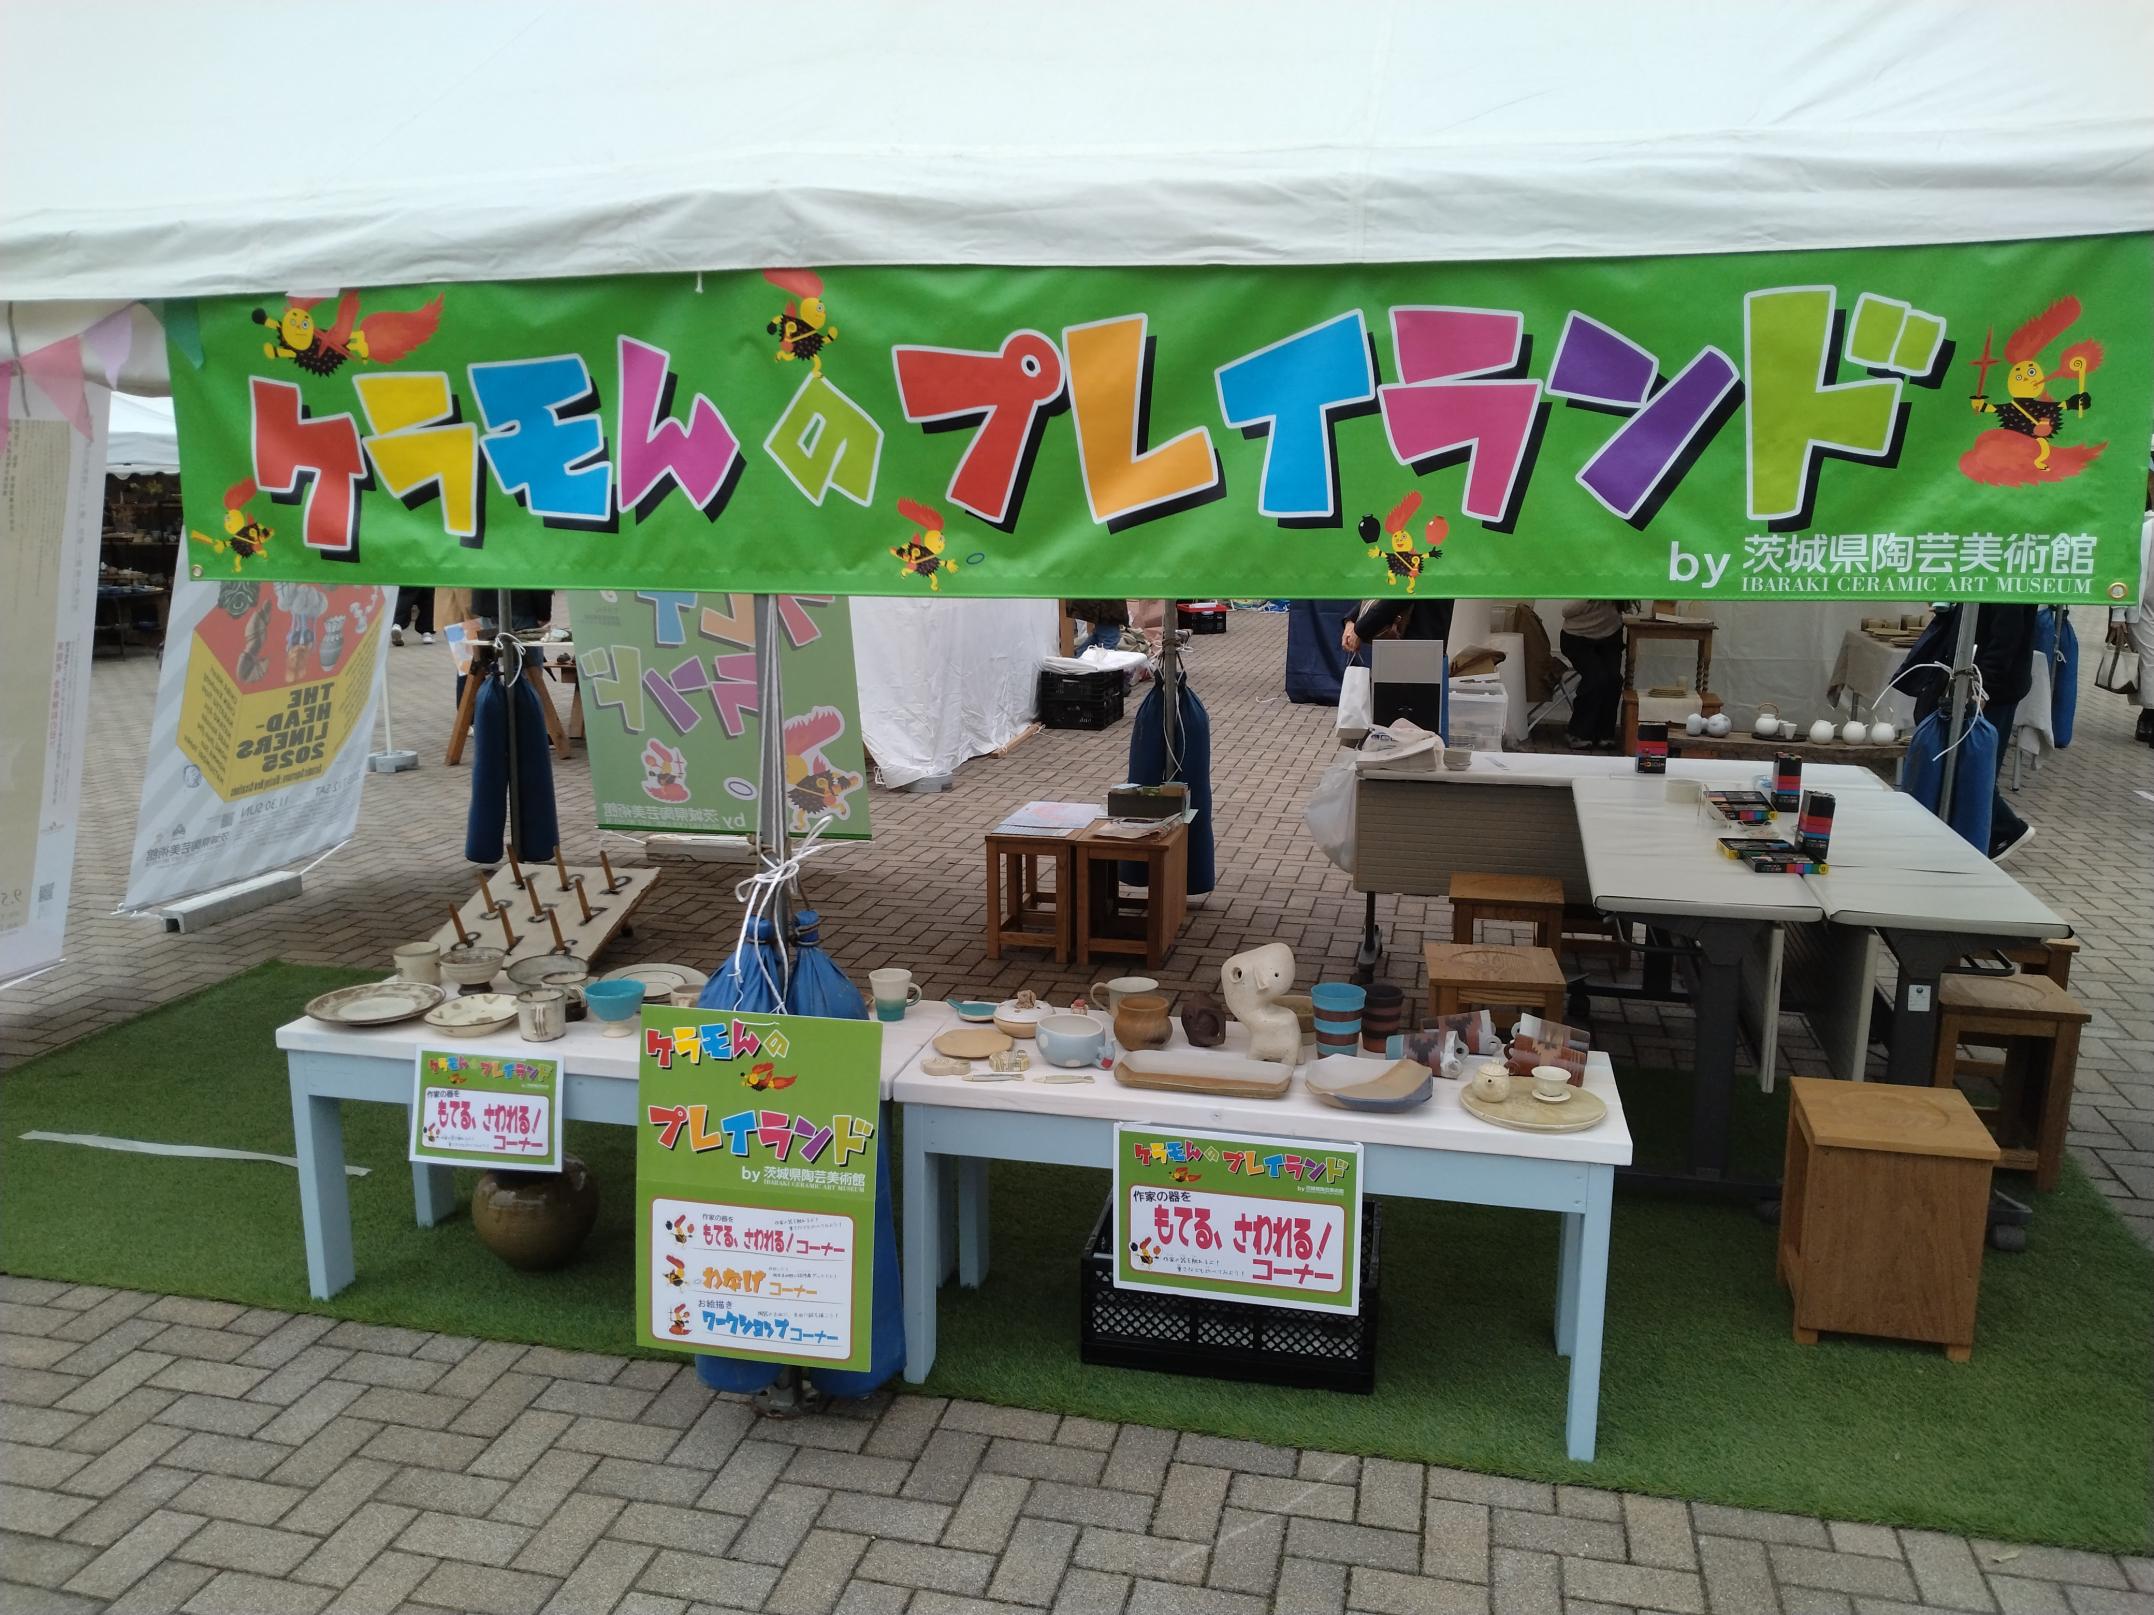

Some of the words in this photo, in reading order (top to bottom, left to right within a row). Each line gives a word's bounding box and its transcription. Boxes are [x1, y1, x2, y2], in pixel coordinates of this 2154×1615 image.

[1668, 541, 1731, 589] by
[1742, 531, 2098, 576] 茨城県陶芸美術館
[1741, 576, 1831, 593] IBARAKI
[1837, 577, 1937, 593] CERAMIC
[1945, 577, 1989, 593] ART
[1996, 577, 2093, 595] MUSEUM
[645, 1018, 791, 1069] ケラモんの
[493, 1135, 543, 1152] コーナー
[647, 1103, 875, 1168] プレイランド
[741, 1165, 760, 1183] by
[763, 1165, 867, 1187] 茨城県陶芸美術館
[1132, 1190, 1192, 1202] 作家の器を
[1251, 1258, 1335, 1285] コーナー
[698, 1300, 733, 1310] お絵描き
